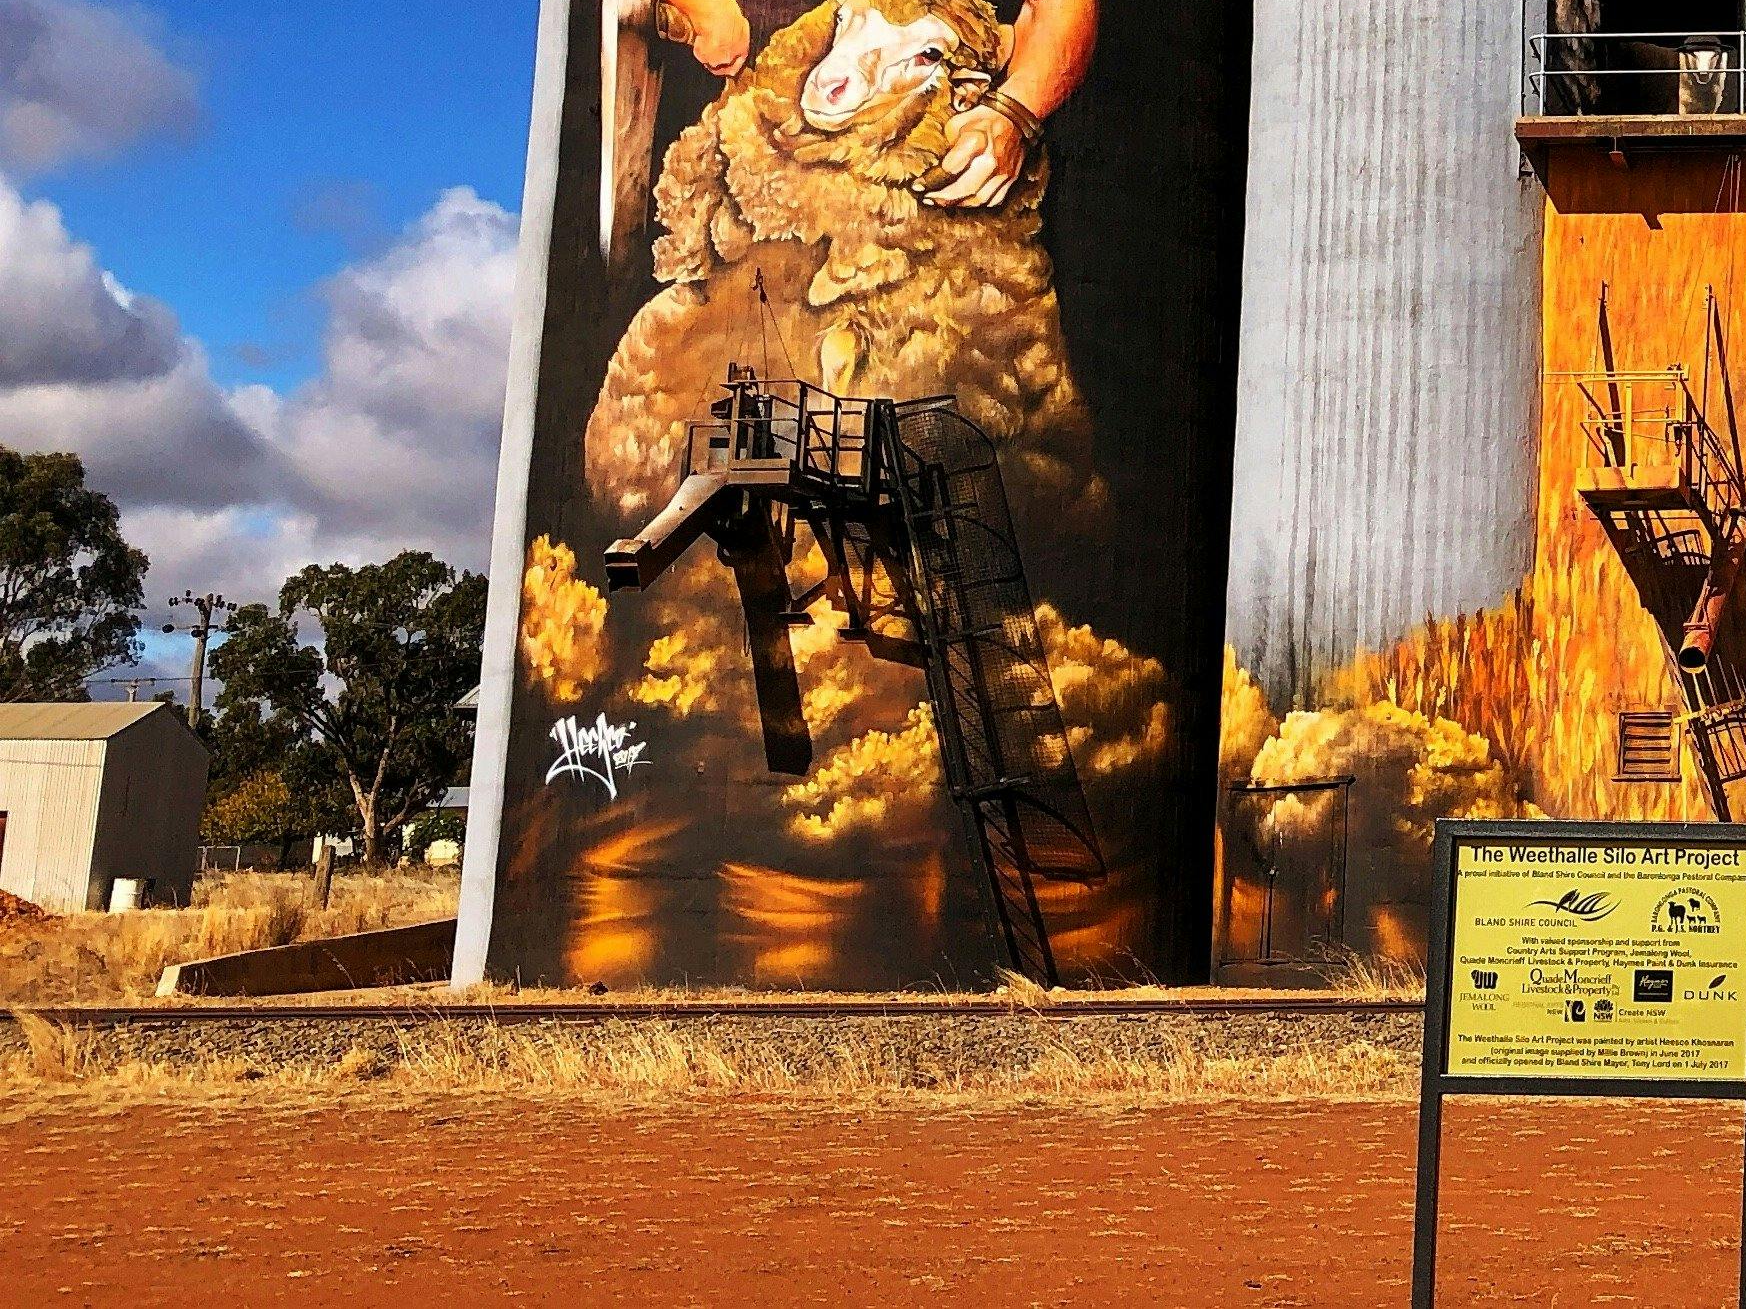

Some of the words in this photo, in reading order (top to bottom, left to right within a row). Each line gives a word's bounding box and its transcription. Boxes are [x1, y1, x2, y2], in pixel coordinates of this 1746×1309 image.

[1471, 846, 1504, 862] The
[1509, 846, 1598, 863] Weethalle
[1603, 847, 1636, 864] Silo
[1641, 847, 1669, 865] Art
[1675, 848, 1739, 869] Project
[1465, 870, 1487, 878] proud
[1489, 870, 1520, 878] initiative
[1522, 870, 1529, 878] of
[1532, 870, 1553, 878] Bland
[1577, 871, 1605, 879] Council
[1607, 871, 1621, 879] and
[1682, 873, 1713, 881] Pastoral
[1475, 917, 1506, 926] BLAND
[1509, 918, 1536, 927] SHIRE
[1538, 919, 1577, 927] COUNCIL
[1541, 937, 1565, 945] valued
[1568, 937, 1613, 946] sponsorship
[1632, 939, 1660, 947] support
[1507, 947, 1537, 956] Country
[1540, 947, 1556, 955] Arts
[1559, 948, 1590, 957] Support
[1630, 949, 1668, 958] Jemalong
[1460, 956, 1486, 964] Quade
[1488, 956, 1525, 965] Moncrieff
[1528, 957, 1565, 965] Livestock
[1613, 959, 1644, 968] Haymes
[1647, 959, 1666, 967] Paint
[1676, 960, 1696, 968] Dunk
[1699, 960, 1738, 969] Insurance
[1459, 993, 1510, 1002] JEMALONG
[1684, 991, 1738, 1001] DUNK
[1472, 1003, 1496, 1011] WOOL
[1593, 1012, 1613, 1021] NSW
[1618, 1009, 1644, 1017] Create
[1646, 1009, 1666, 1017] NSW
[1458, 1034, 1472, 1042] The
[1475, 1034, 1513, 1043] Weethalle
[1515, 1035, 1529, 1043] Silo
[1532, 1035, 1544, 1043] Art
[1546, 1036, 1574, 1045] Project
[1594, 1037, 1623, 1045] painted
[1625, 1038, 1635, 1046] by
[1660, 1038, 1689, 1046] Heesco
[1491, 1047, 1523, 1056] (original
[1525, 1047, 1549, 1056] image
[1551, 1048, 1584, 1057] supplied
[1586, 1048, 1596, 1057] by
[1659, 1049, 1678, 1057] June
[1478, 1057, 1511, 1066] officially
[1514, 1058, 1543, 1066] opened
[1545, 1058, 1554, 1066] by
[1556, 1058, 1579, 1066] Bland
[1632, 1059, 1650, 1069] Tony
[1691, 1060, 1707, 1070] July
[1709, 1060, 1728, 1068] 2017
